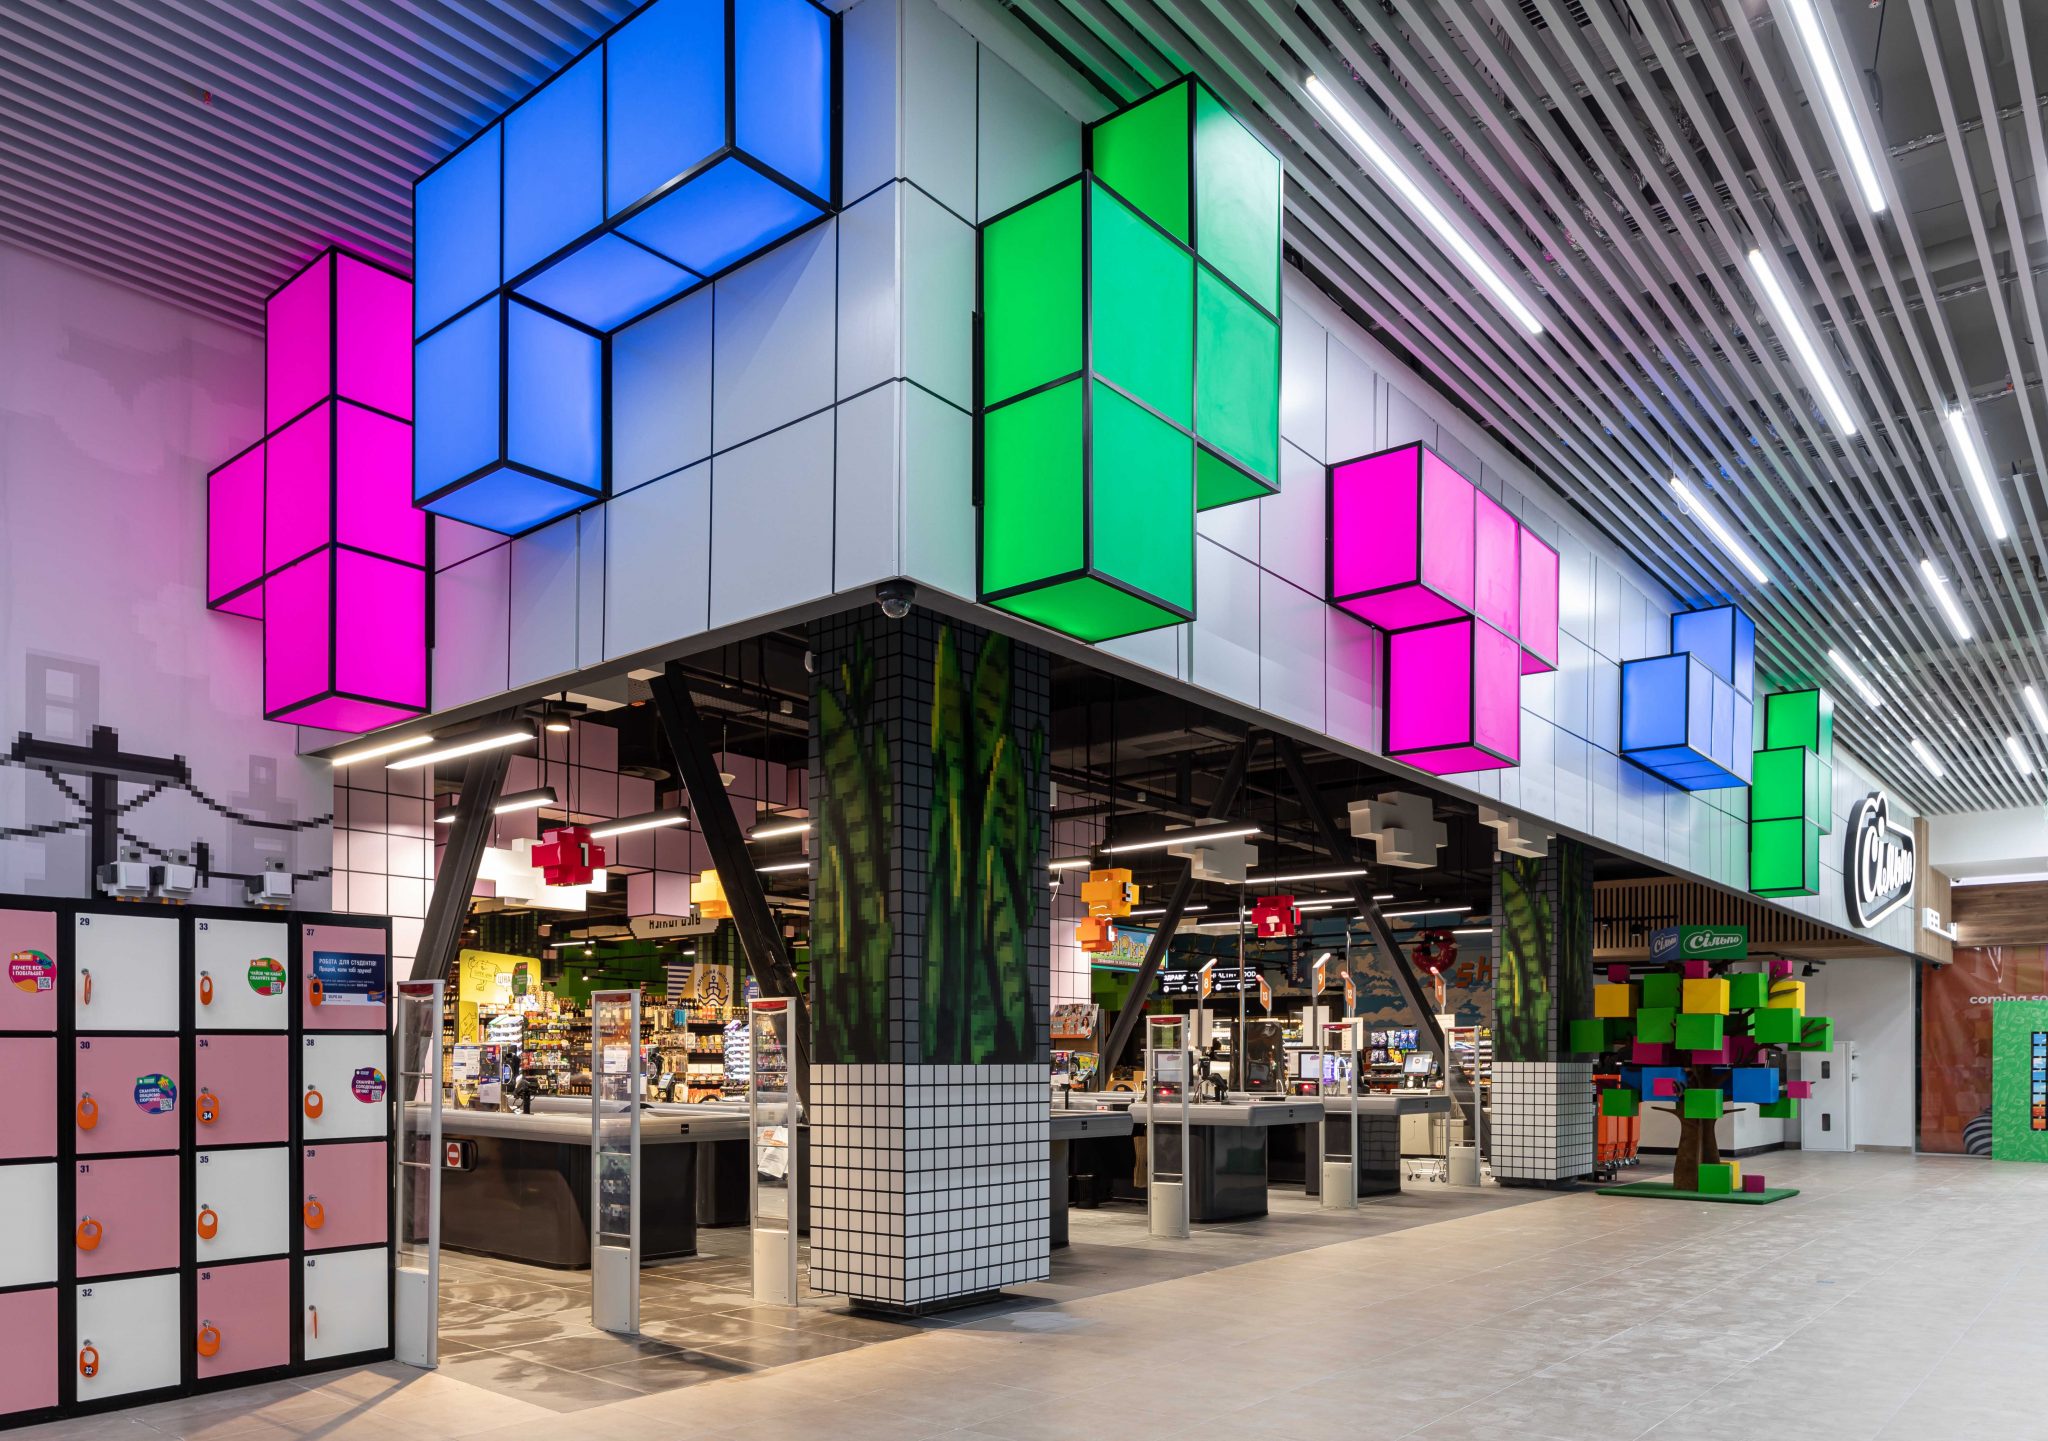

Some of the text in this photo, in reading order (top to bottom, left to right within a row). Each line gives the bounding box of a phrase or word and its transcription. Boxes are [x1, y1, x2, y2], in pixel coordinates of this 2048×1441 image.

[1862, 816, 1913, 903] Сільпо
[1690, 932, 1739, 949] Сільпо
[1203, 978, 1209, 989] 8
[80, 1041, 90, 1049] 30
[203, 1112, 212, 1120] 34
[80, 1165, 89, 1173] 31
[201, 1272, 210, 1280] 36
